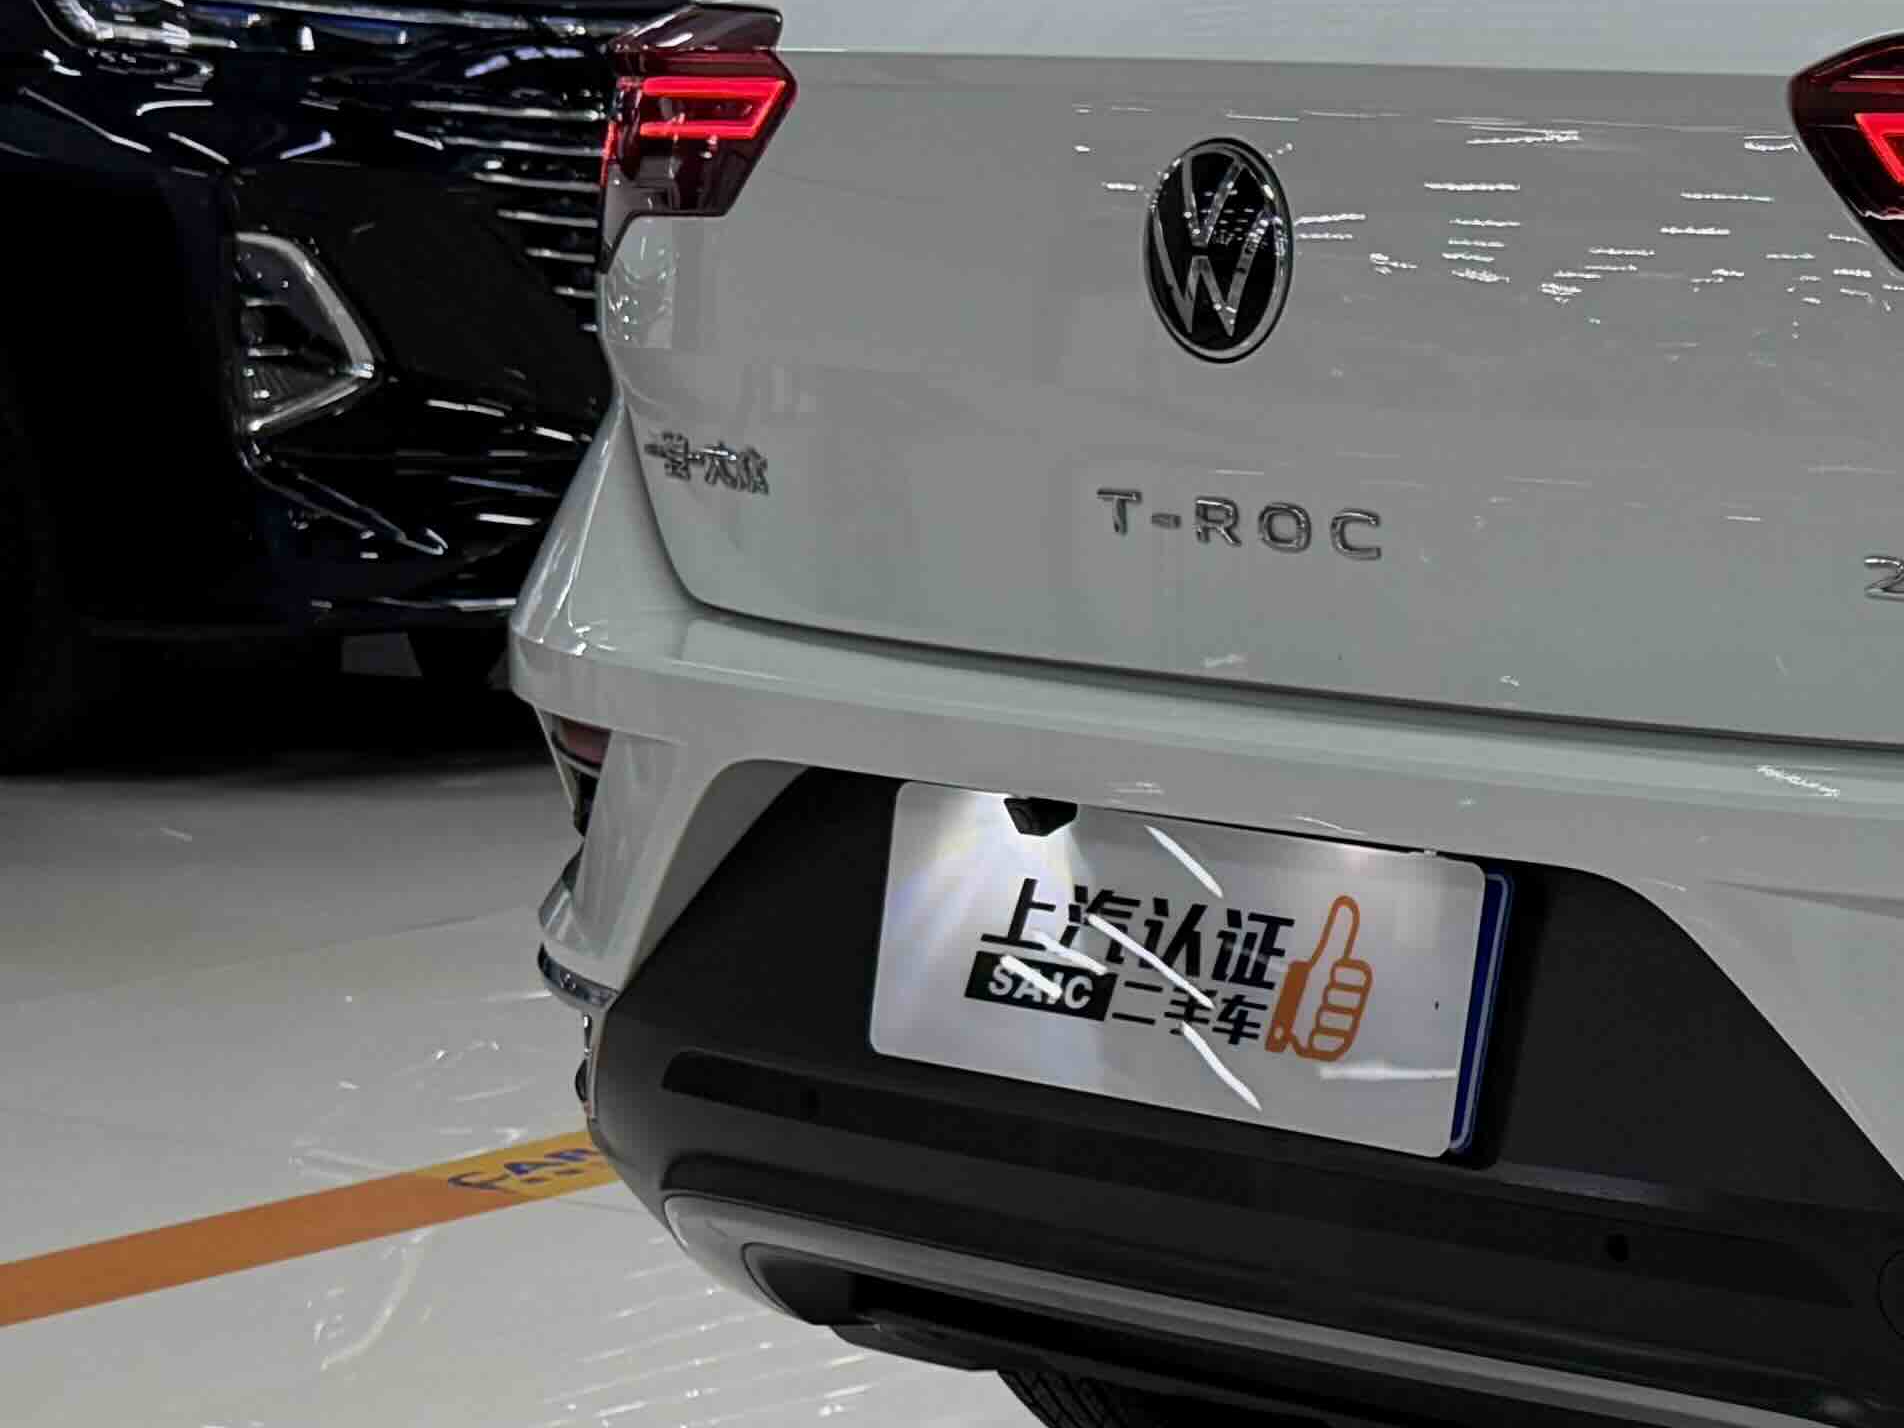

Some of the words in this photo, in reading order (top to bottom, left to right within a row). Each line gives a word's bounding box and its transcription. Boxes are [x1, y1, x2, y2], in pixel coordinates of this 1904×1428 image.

[1096, 487, 1384, 562] T-ROC
[980, 878, 1295, 990] 上汽认证
[1112, 978, 1268, 1046] 二手车
